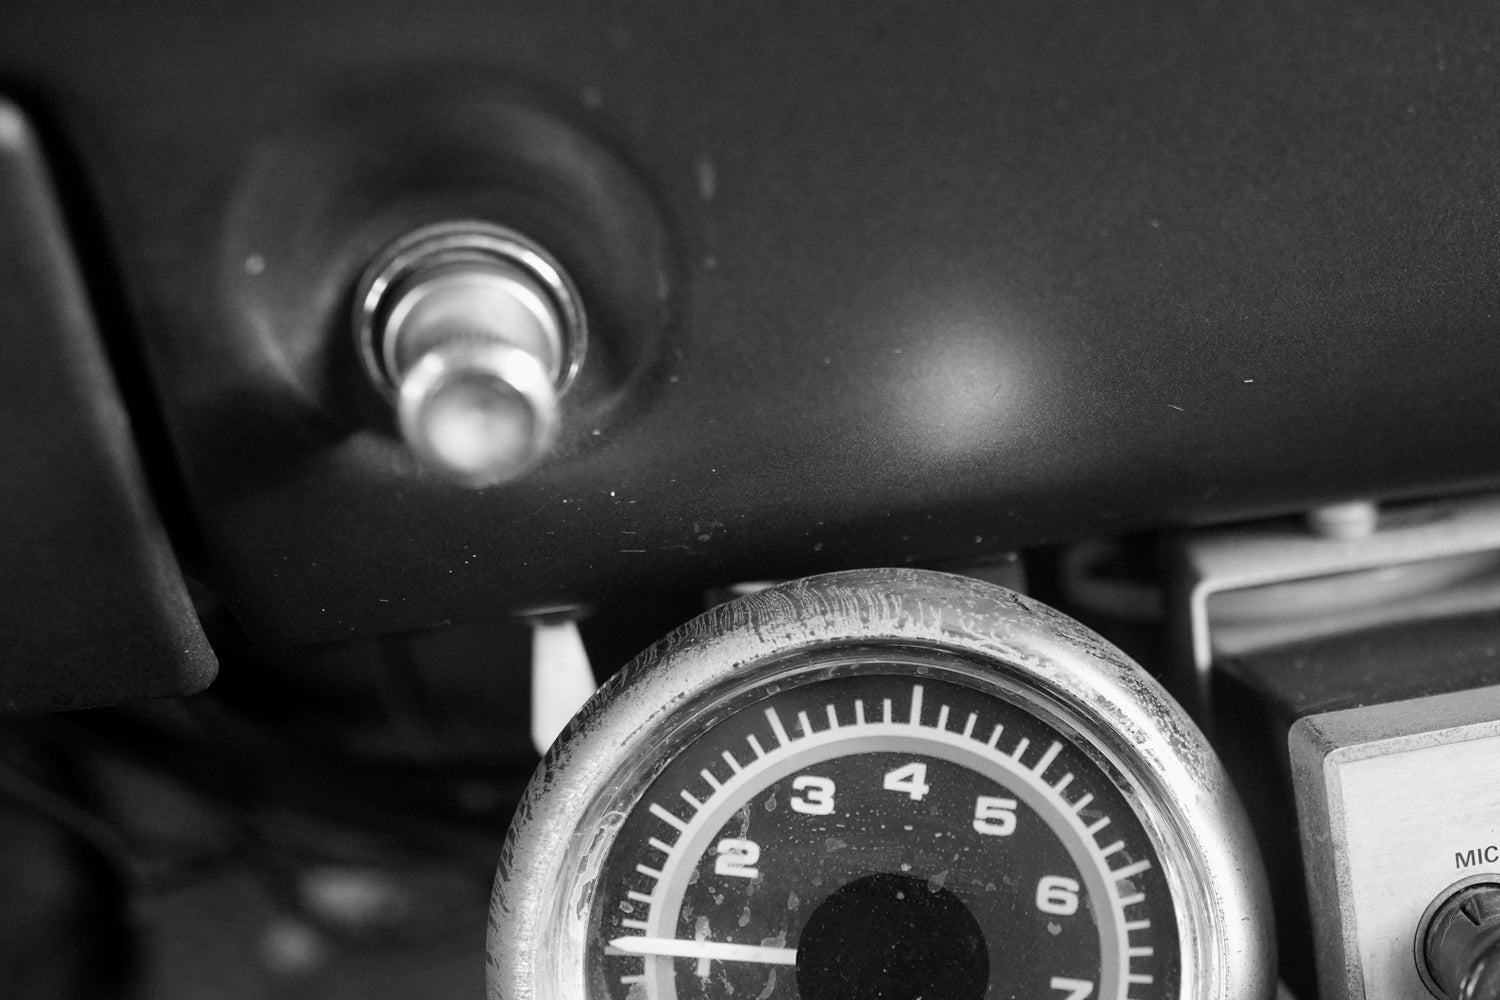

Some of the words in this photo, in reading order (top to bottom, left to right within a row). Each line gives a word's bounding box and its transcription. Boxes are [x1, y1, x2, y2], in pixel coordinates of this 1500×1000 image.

[790, 776, 836, 815] 3
[883, 763, 929, 800] 4
[973, 796, 1017, 836] 5
[714, 839, 760, 878] 2
[1455, 845, 1500, 870] MIC
[1036, 876, 1080, 915] 6
